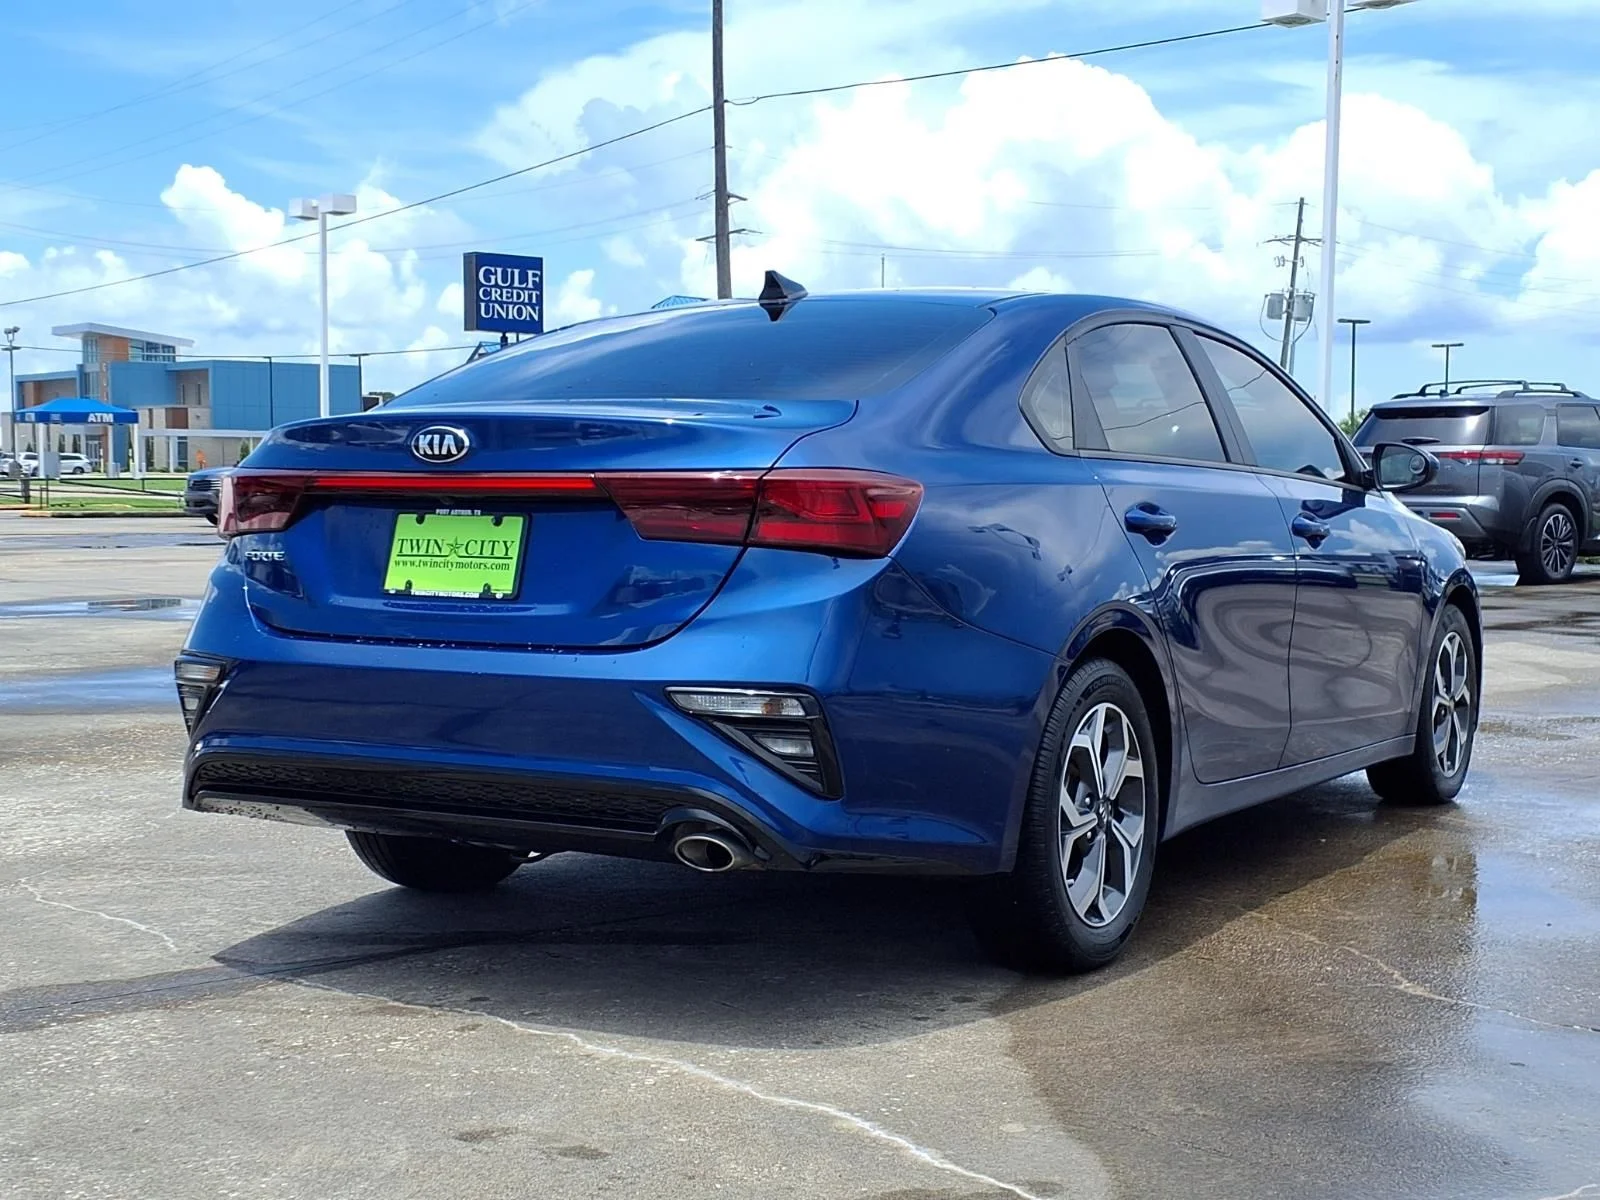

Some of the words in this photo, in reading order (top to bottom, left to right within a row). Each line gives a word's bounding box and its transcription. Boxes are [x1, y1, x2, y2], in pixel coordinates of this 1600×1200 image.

[478, 265, 541, 289] GULF
[478, 286, 540, 303] CREDIT
[480, 302, 539, 321] UNION
[87, 412, 114, 423] ATM
[418, 434, 458, 455] KIA
[397, 538, 445, 554] TWIN
[464, 539, 515, 557] CITY
[394, 558, 510, 571] www.twincitymotors.com
